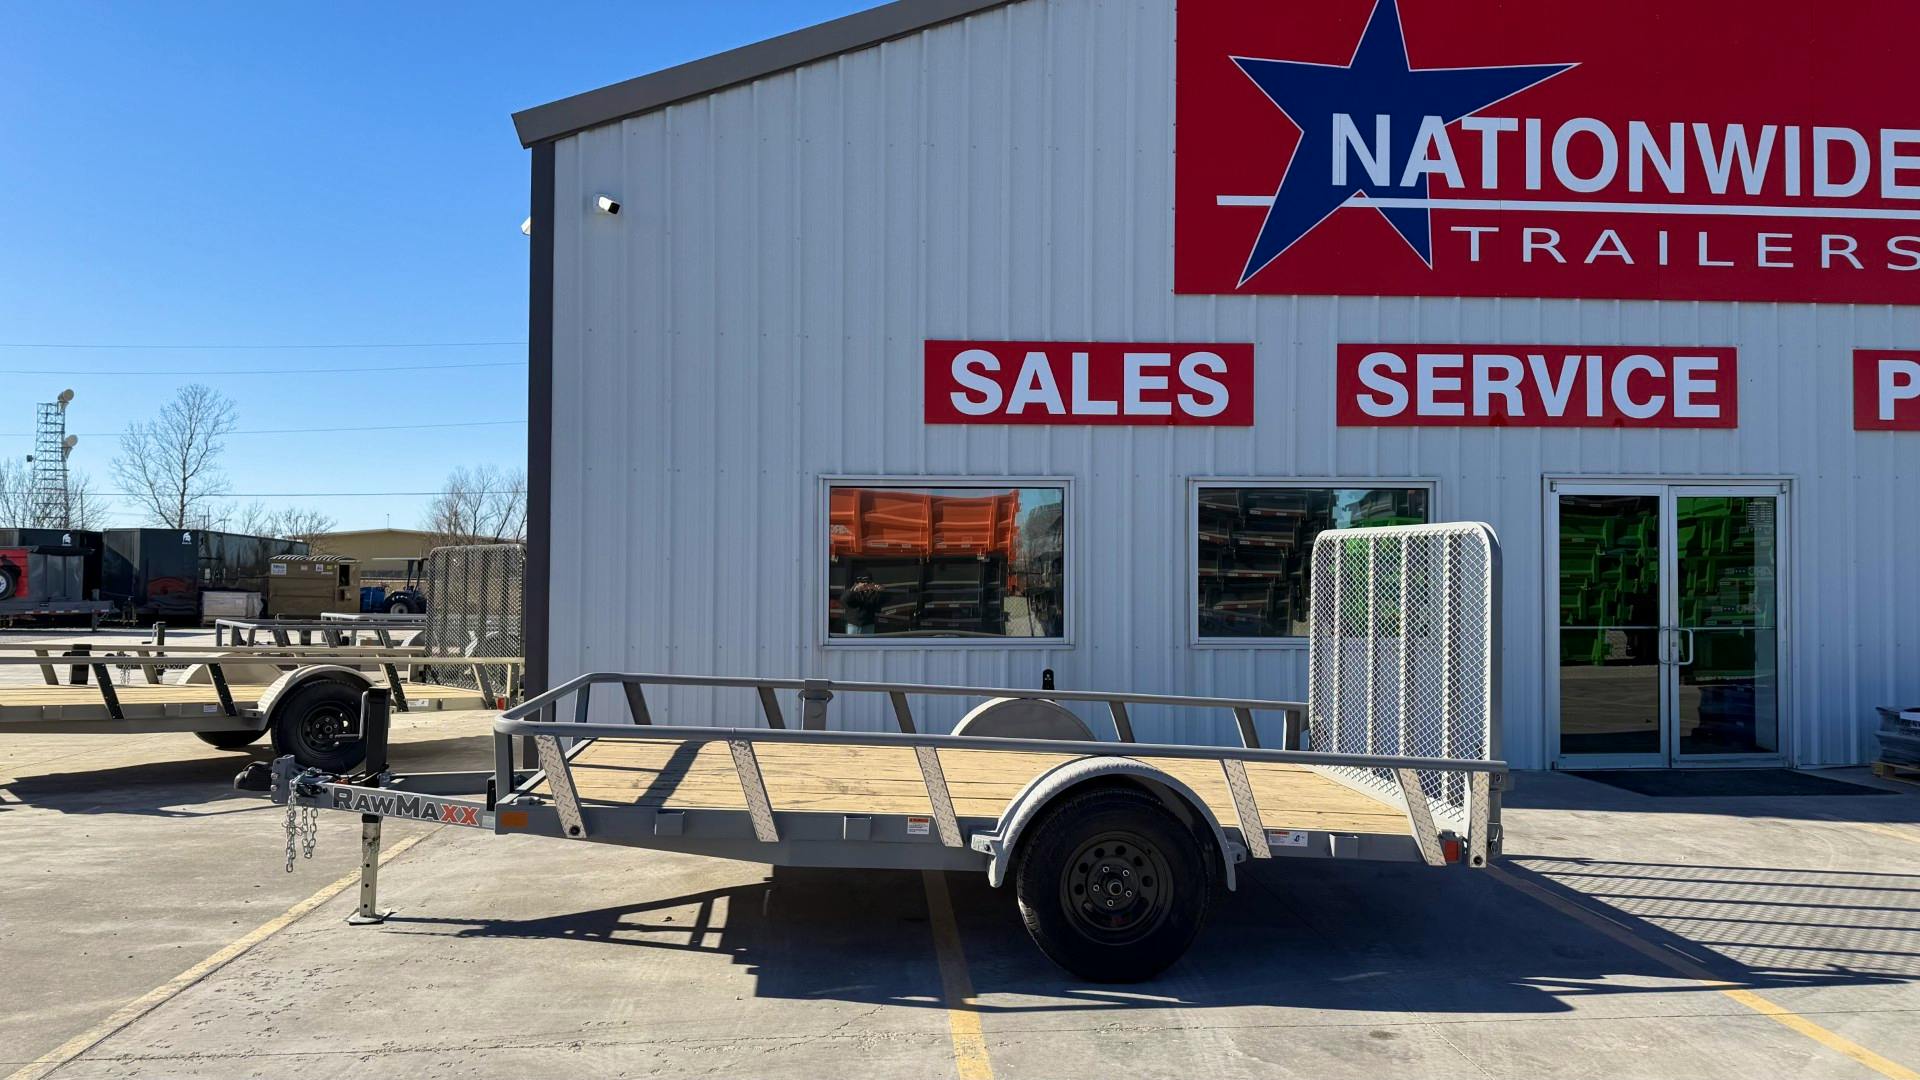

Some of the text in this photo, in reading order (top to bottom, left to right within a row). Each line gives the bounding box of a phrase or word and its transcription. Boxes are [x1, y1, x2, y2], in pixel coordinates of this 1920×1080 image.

[1332, 113, 1920, 199] NATIONWIDE
[1451, 226, 1920, 271] TRAILERS
[950, 349, 1229, 417] SALES
[1356, 352, 1721, 418] SERVICE
